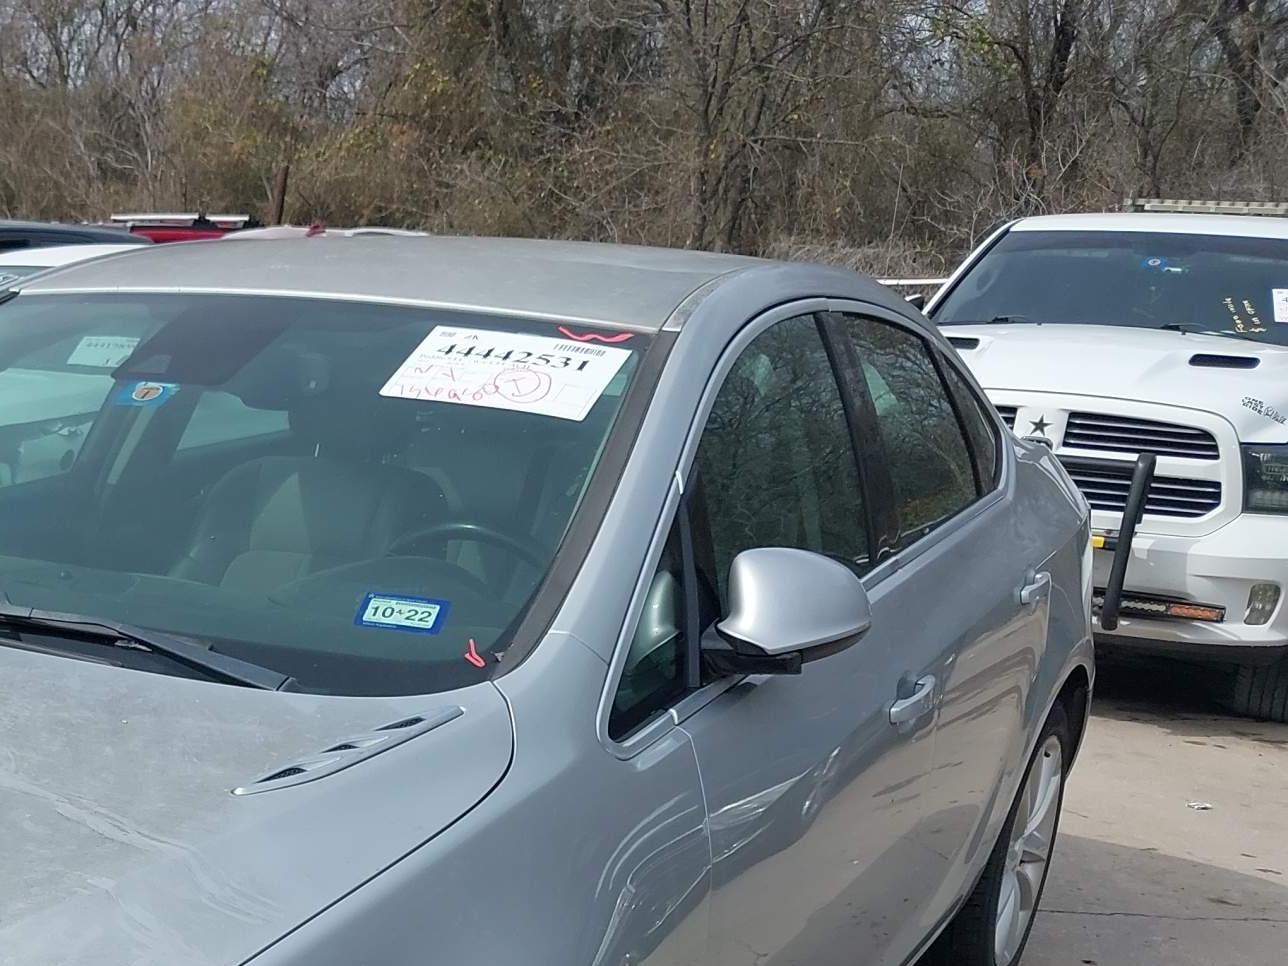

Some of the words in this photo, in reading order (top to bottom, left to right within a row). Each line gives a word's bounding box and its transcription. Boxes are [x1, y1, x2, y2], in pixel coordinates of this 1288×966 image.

[435, 342, 590, 372] 44442531
[371, 605, 395, 619] 10
[404, 608, 432, 623] 22
